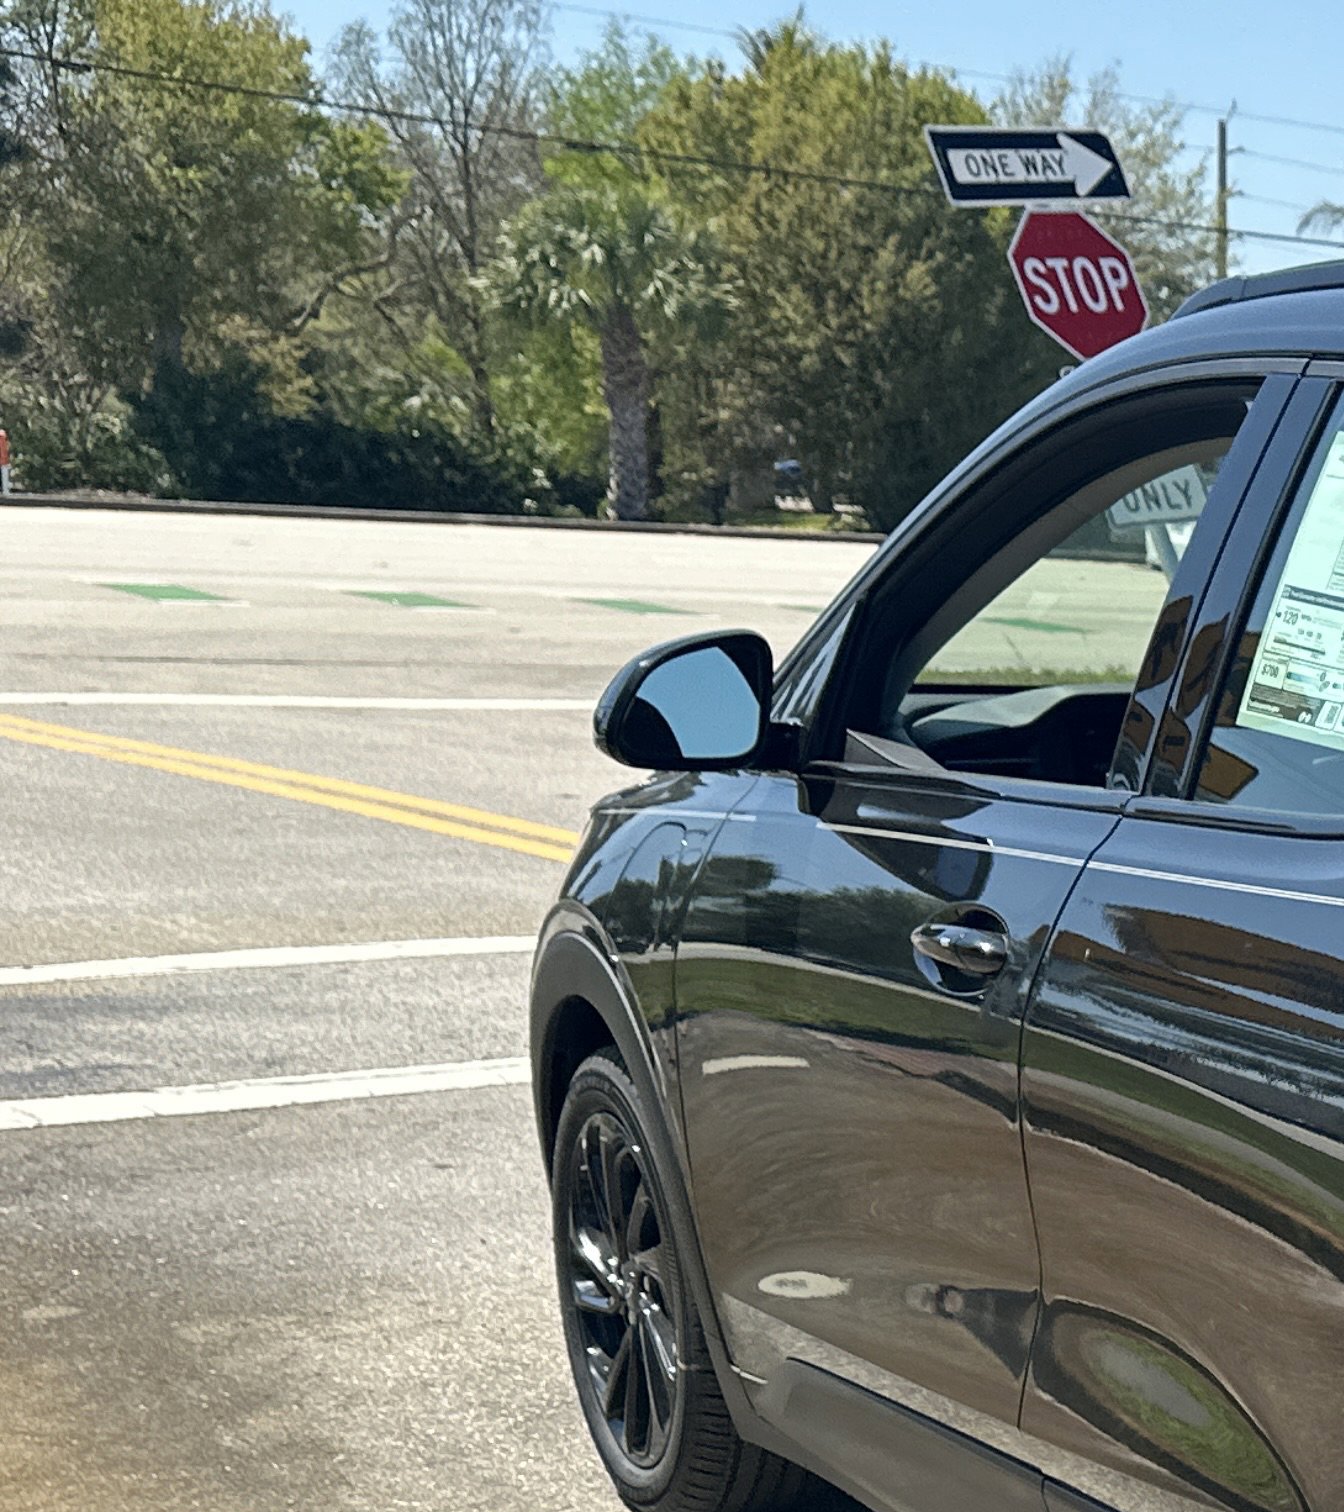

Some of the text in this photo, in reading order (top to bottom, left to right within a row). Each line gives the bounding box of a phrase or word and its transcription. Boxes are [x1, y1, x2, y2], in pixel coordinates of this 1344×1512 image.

[965, 153, 1068, 177] ONE WAY
[1023, 256, 1129, 315] STOP
[1121, 479, 1193, 513] ONLY
